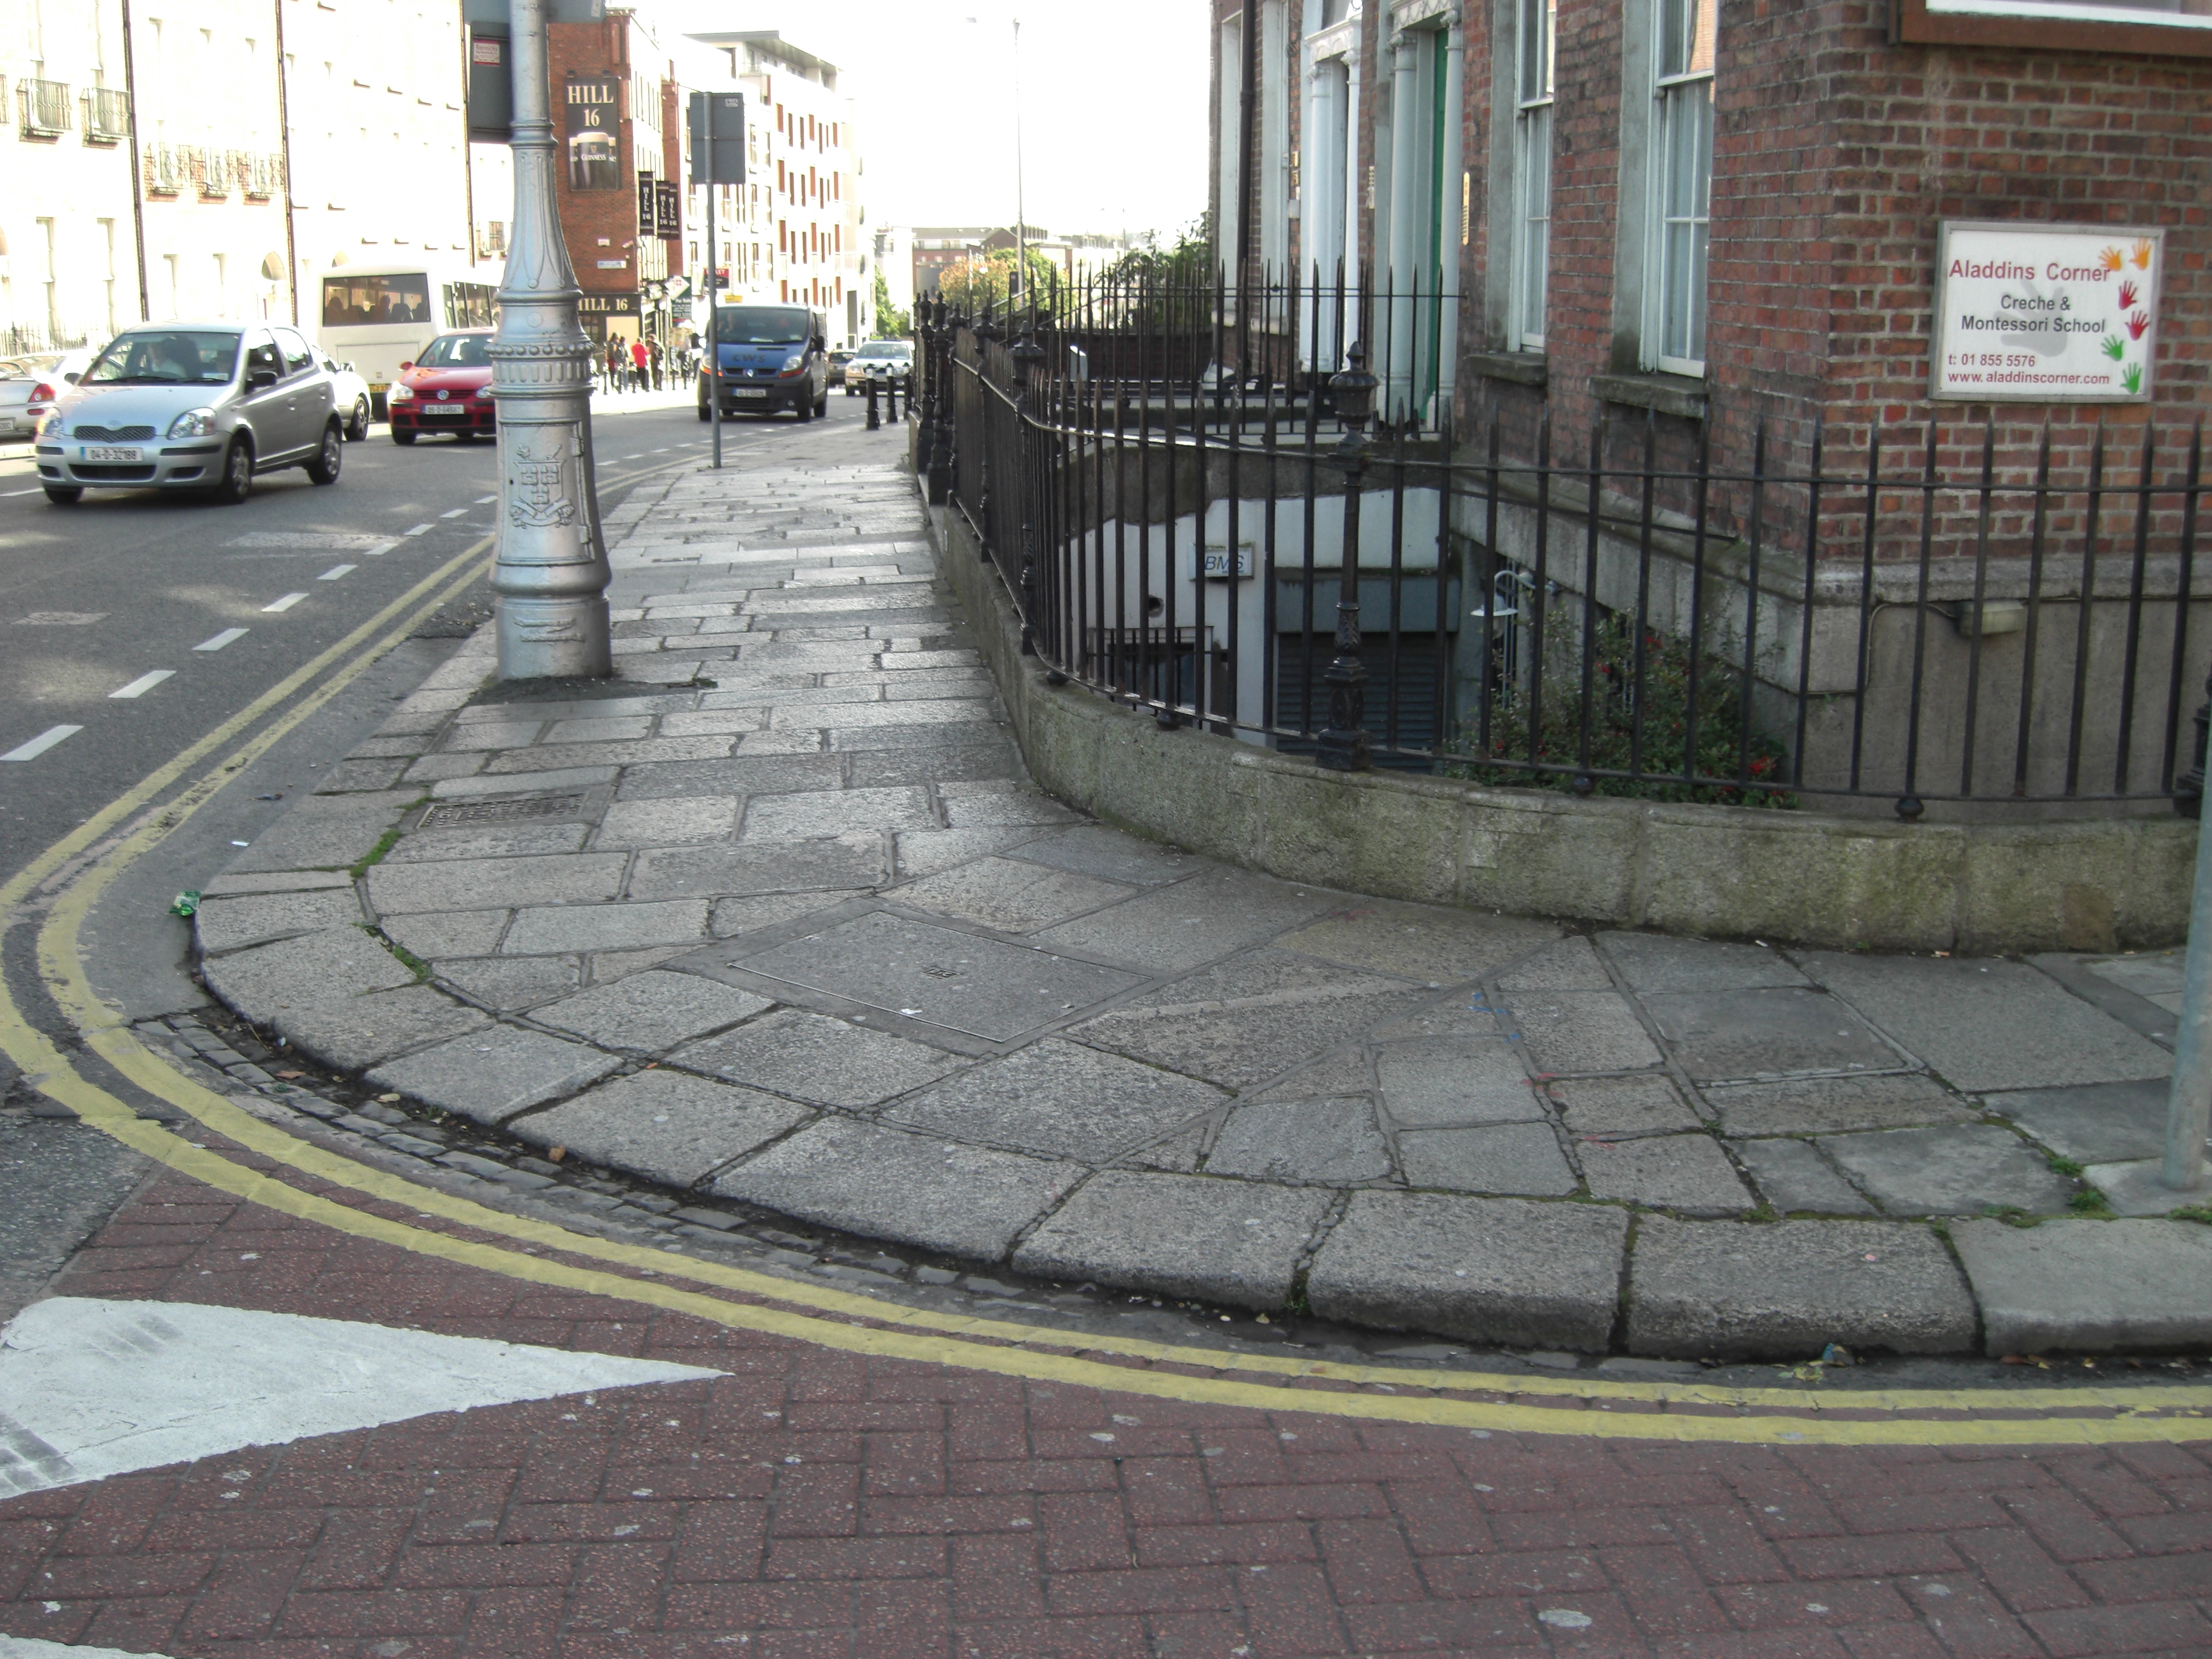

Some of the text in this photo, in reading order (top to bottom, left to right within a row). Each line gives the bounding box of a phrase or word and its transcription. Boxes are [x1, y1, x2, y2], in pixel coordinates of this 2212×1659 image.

[567, 85, 614, 104] HILL
[584, 109, 600, 127] 16
[1949, 260, 2110, 281] Aladdins Corner
[615, 298, 628, 311] 16
[2001, 295, 2070, 310] Creche &
[1962, 315, 2105, 333] Montessori School
[732, 354, 765, 363] CWS
[1948, 354, 2035, 367] t: 01 855 5576
[1986, 371, 2110, 384] aladdinscorner.com
[1205, 555, 1244, 571] BMS
